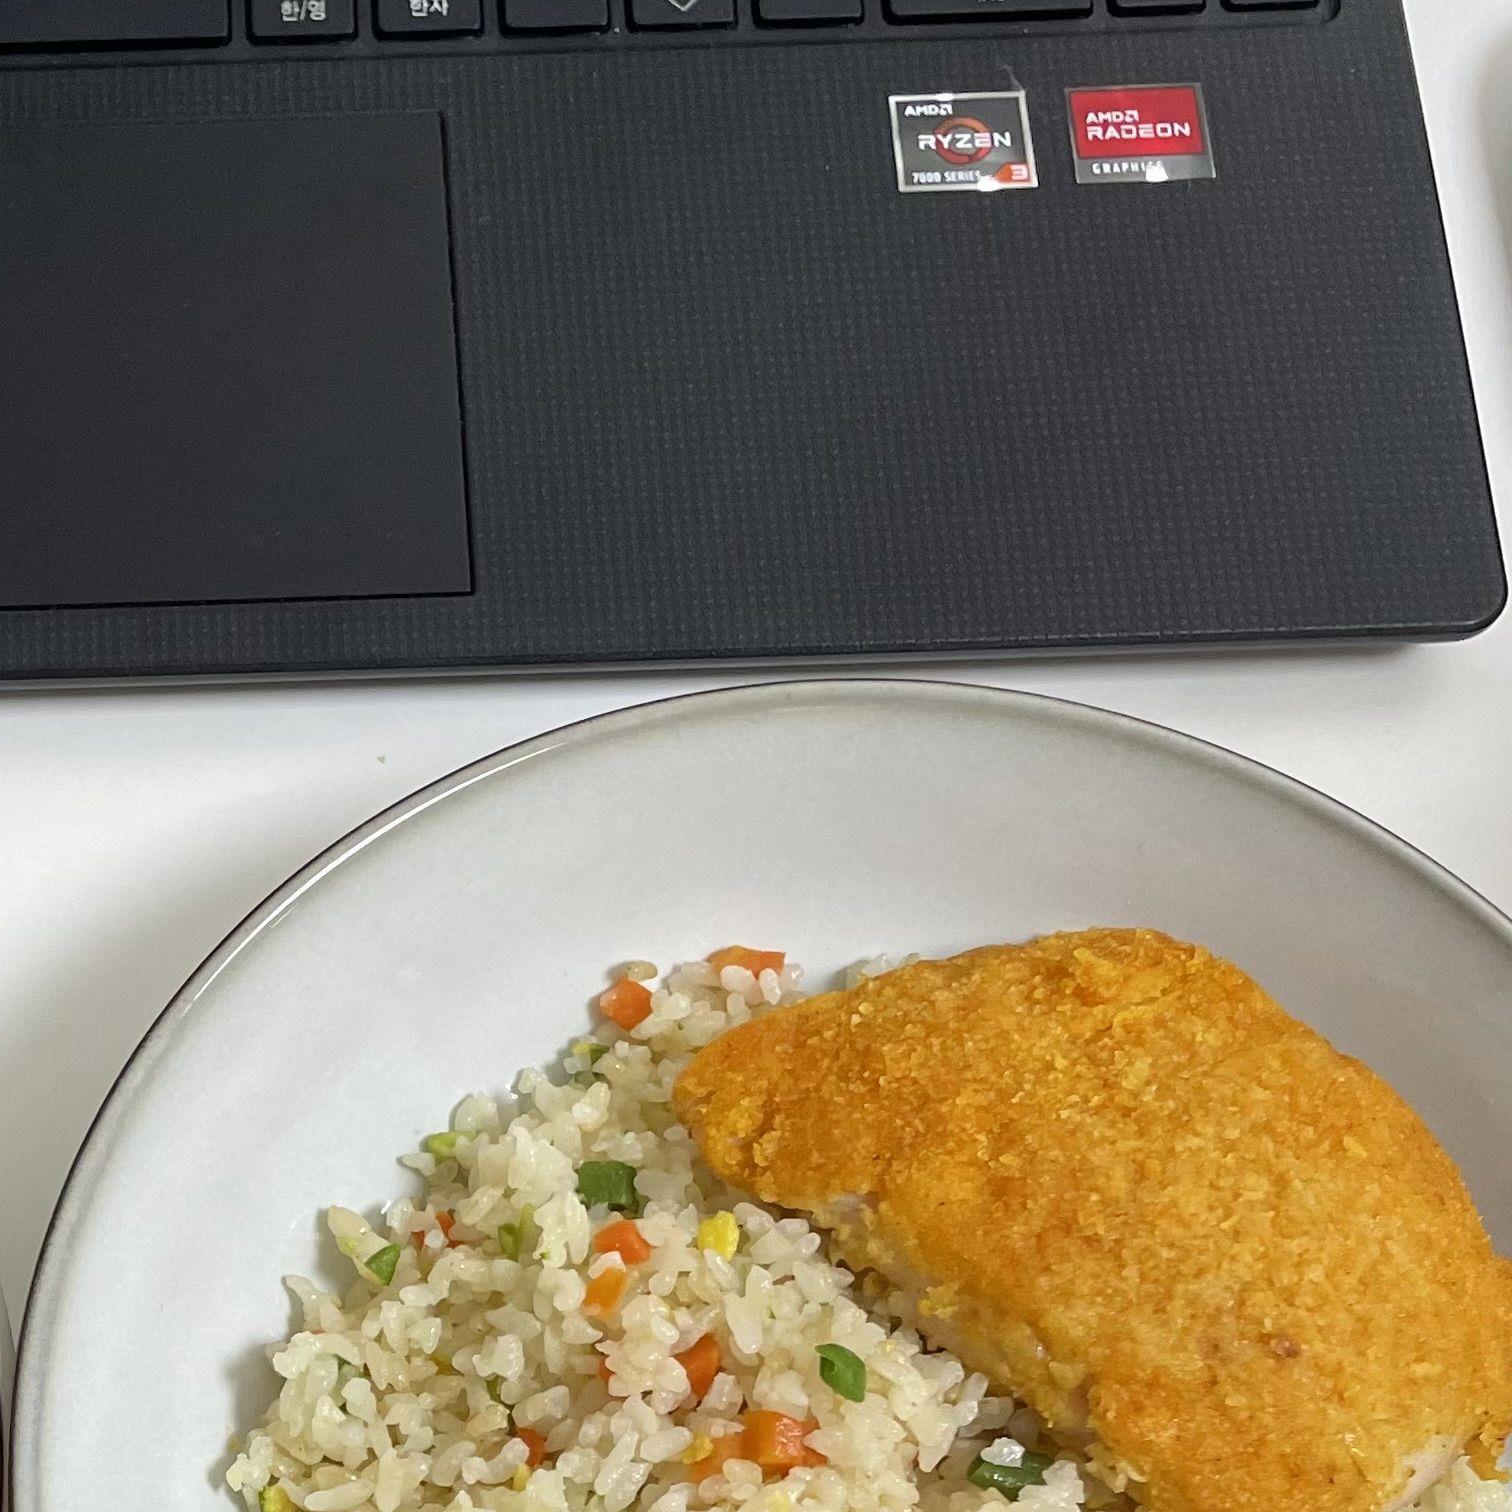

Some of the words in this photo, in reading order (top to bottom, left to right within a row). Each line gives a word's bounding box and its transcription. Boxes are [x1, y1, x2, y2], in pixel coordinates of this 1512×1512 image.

[280, 0, 327, 21] 한/영
[904, 104, 940, 117] AMD
[1086, 110, 1125, 123] AMD
[918, 131, 1011, 150] RYZEN
[1087, 122, 1191, 141] RADEON
[1010, 164, 1029, 181] 3
